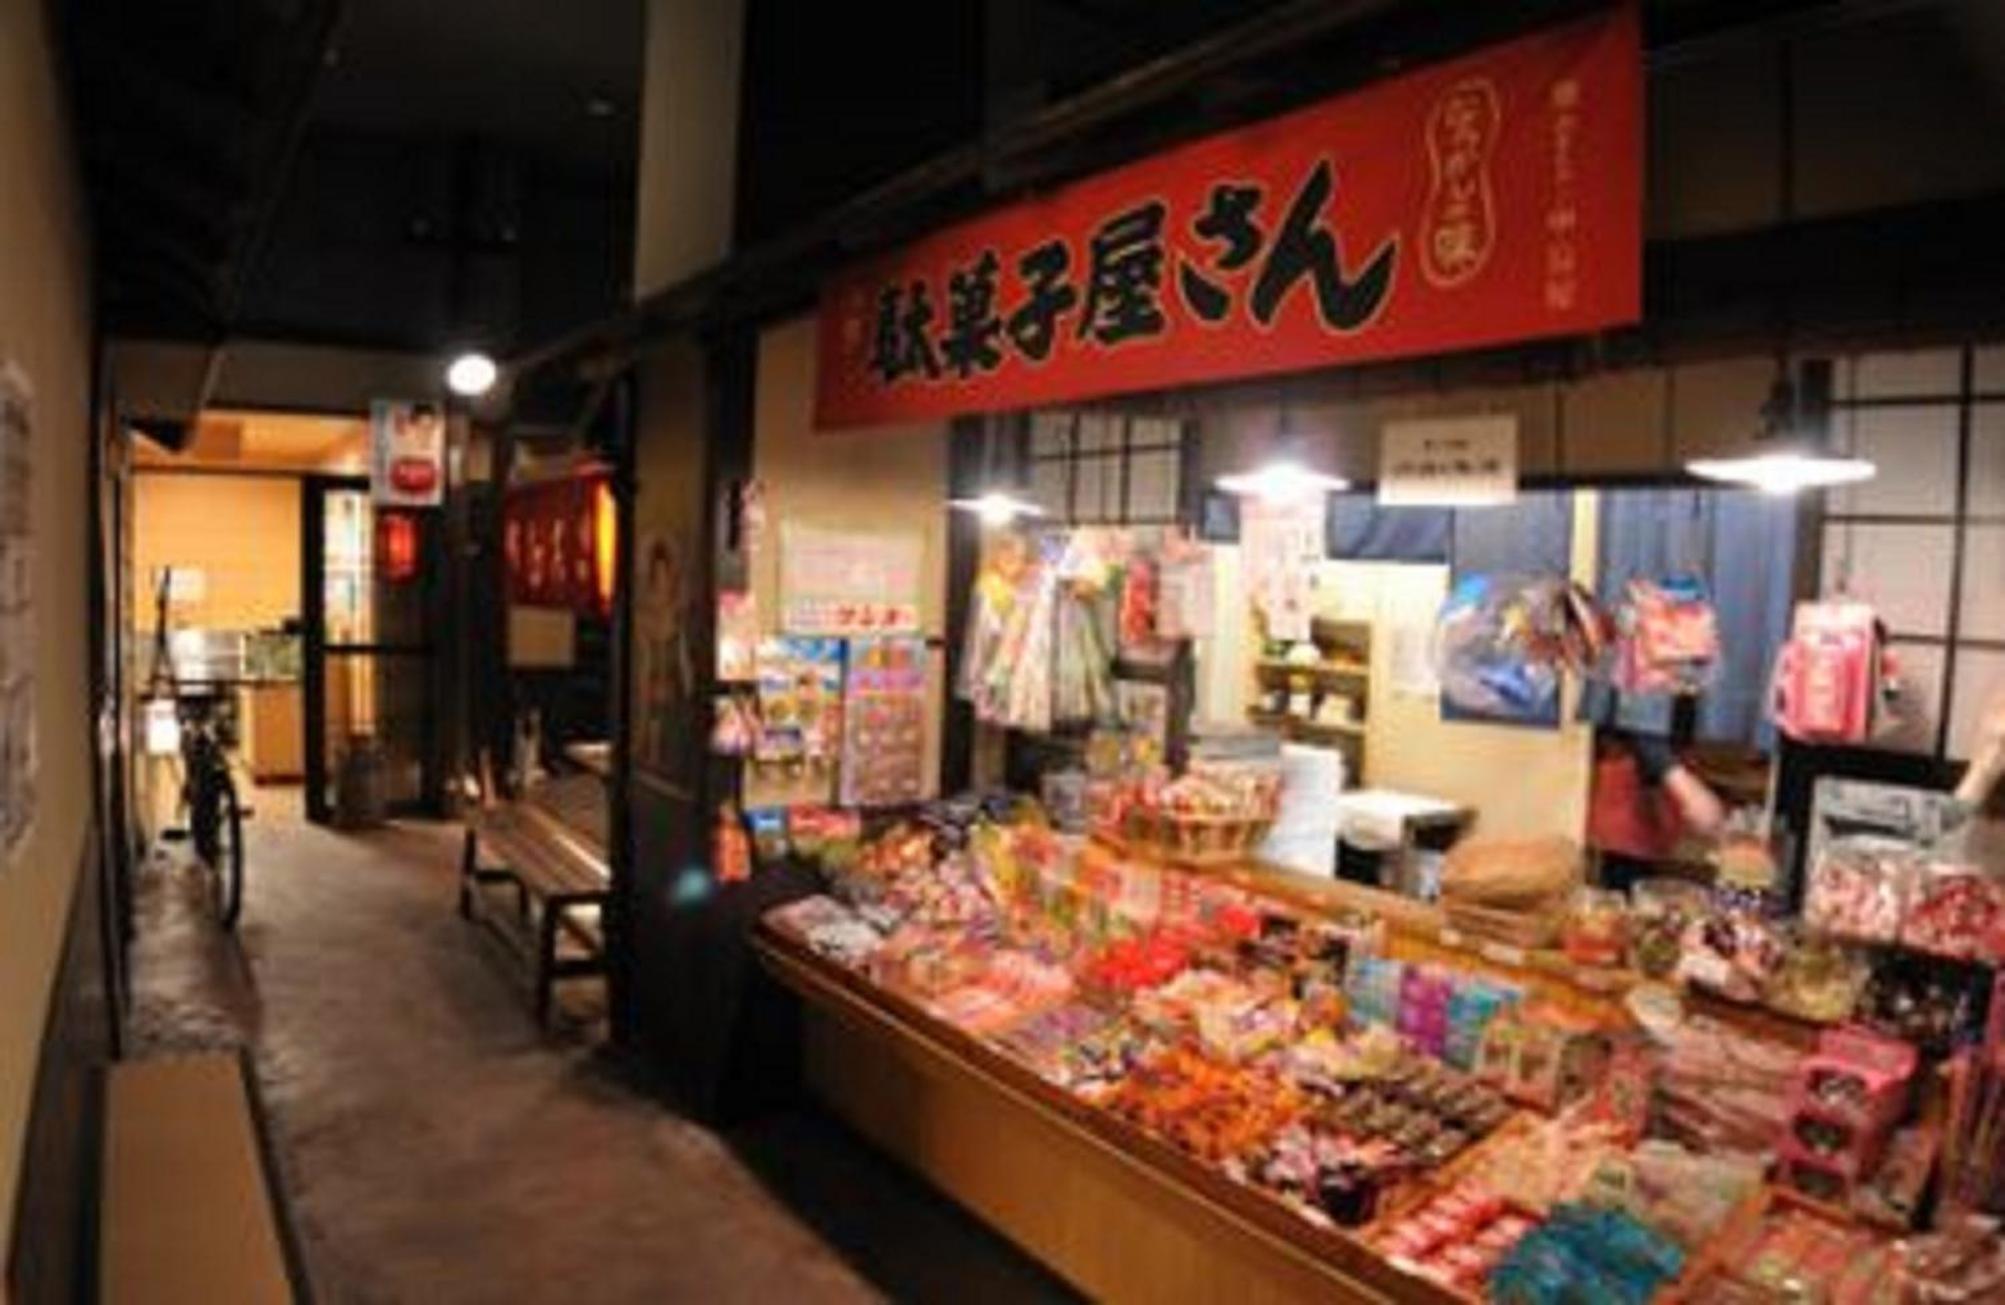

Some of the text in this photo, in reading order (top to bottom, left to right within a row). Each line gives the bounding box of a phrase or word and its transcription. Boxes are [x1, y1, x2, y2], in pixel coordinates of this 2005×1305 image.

[871, 160, 1398, 382] 駄菓子屋さん
